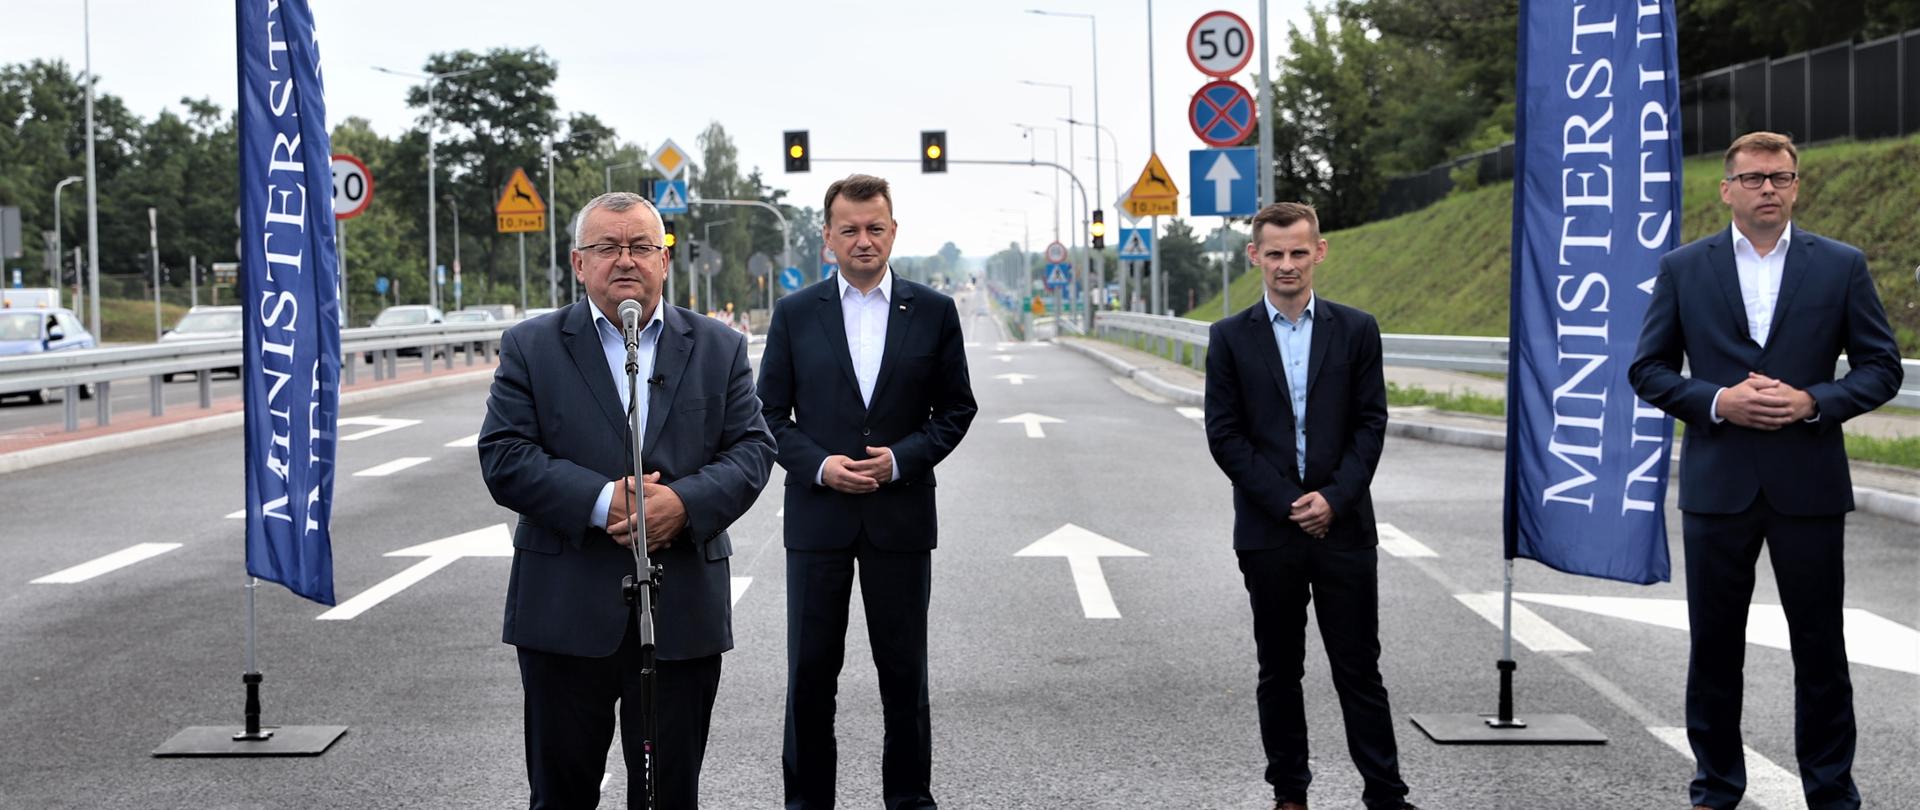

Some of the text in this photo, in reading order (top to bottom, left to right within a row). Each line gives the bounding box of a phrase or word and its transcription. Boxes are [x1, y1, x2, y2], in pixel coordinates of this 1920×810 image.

[261, 0, 306, 522] MINISTERST
[1200, 28, 1244, 60] 50
[1543, 0, 1617, 515] MINISTERST
